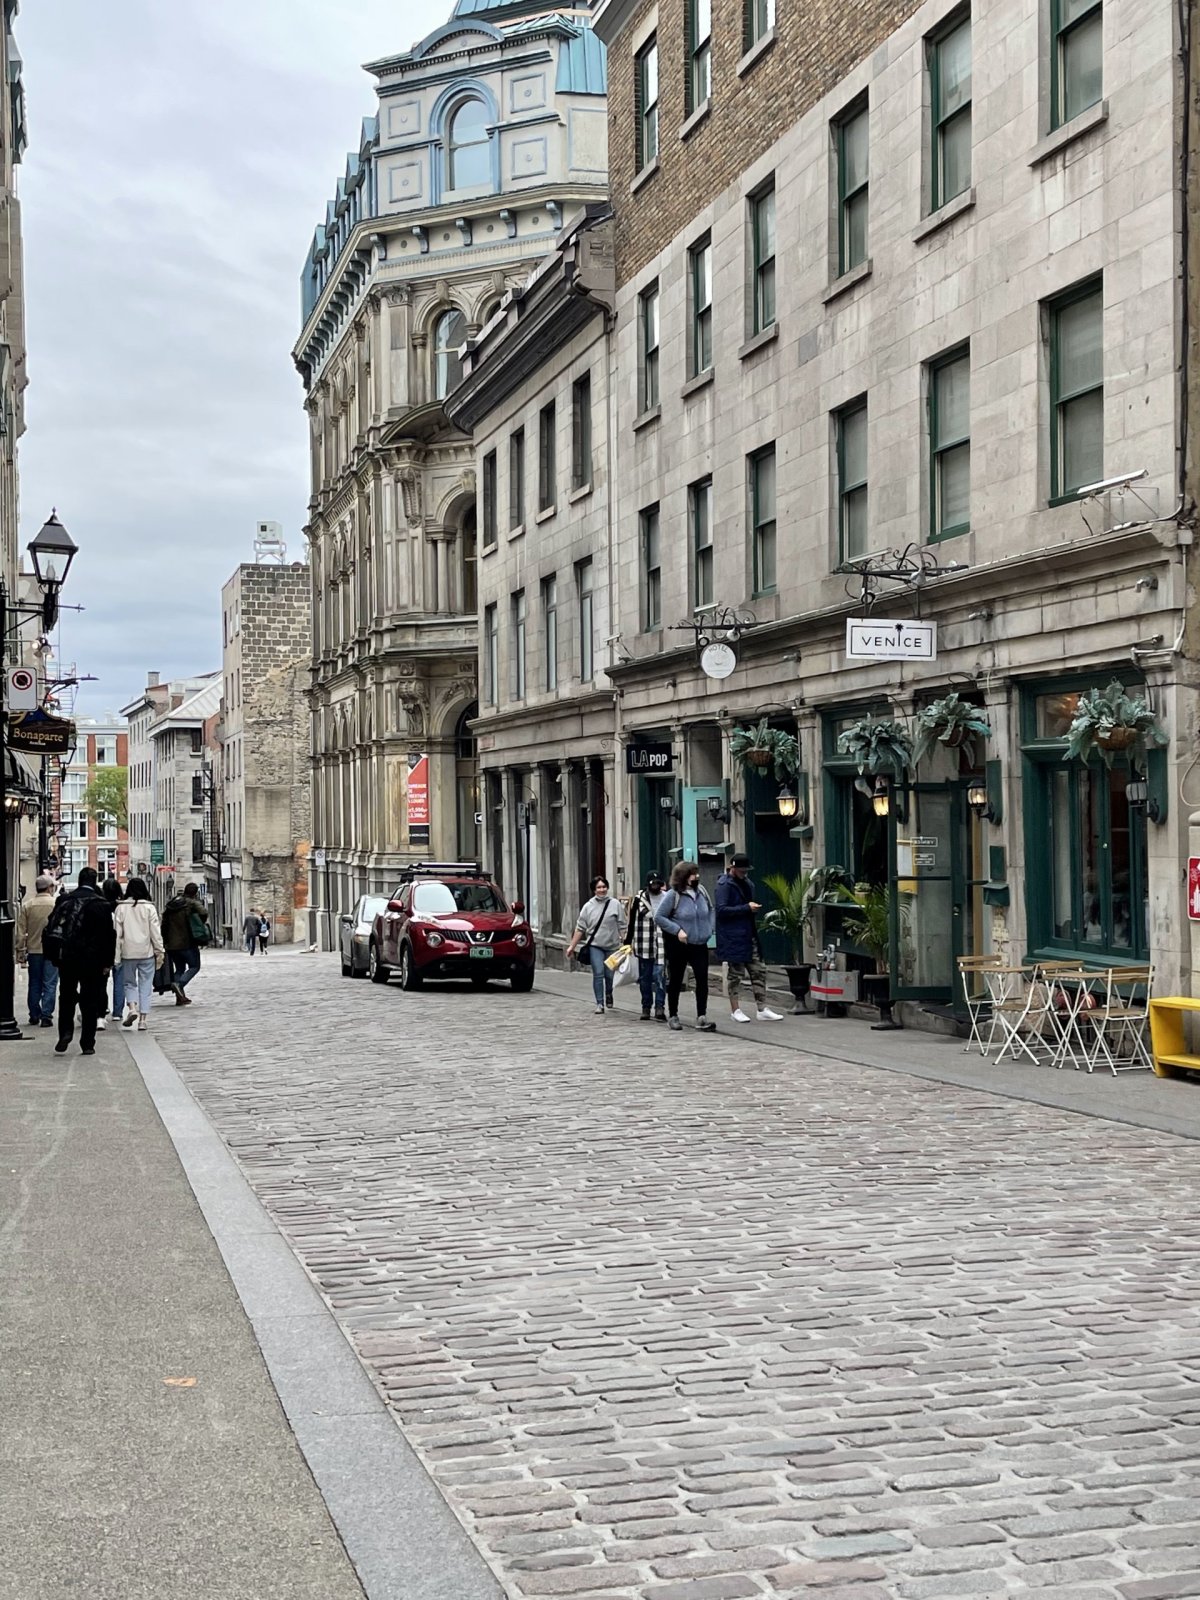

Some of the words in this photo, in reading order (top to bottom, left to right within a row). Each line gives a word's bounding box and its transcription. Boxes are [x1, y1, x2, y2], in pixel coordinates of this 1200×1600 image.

[861, 630, 922, 648] VENICE
[13, 727, 64, 742] Bonaparte
[631, 749, 649, 768] LA
[649, 753, 668, 767] POP
